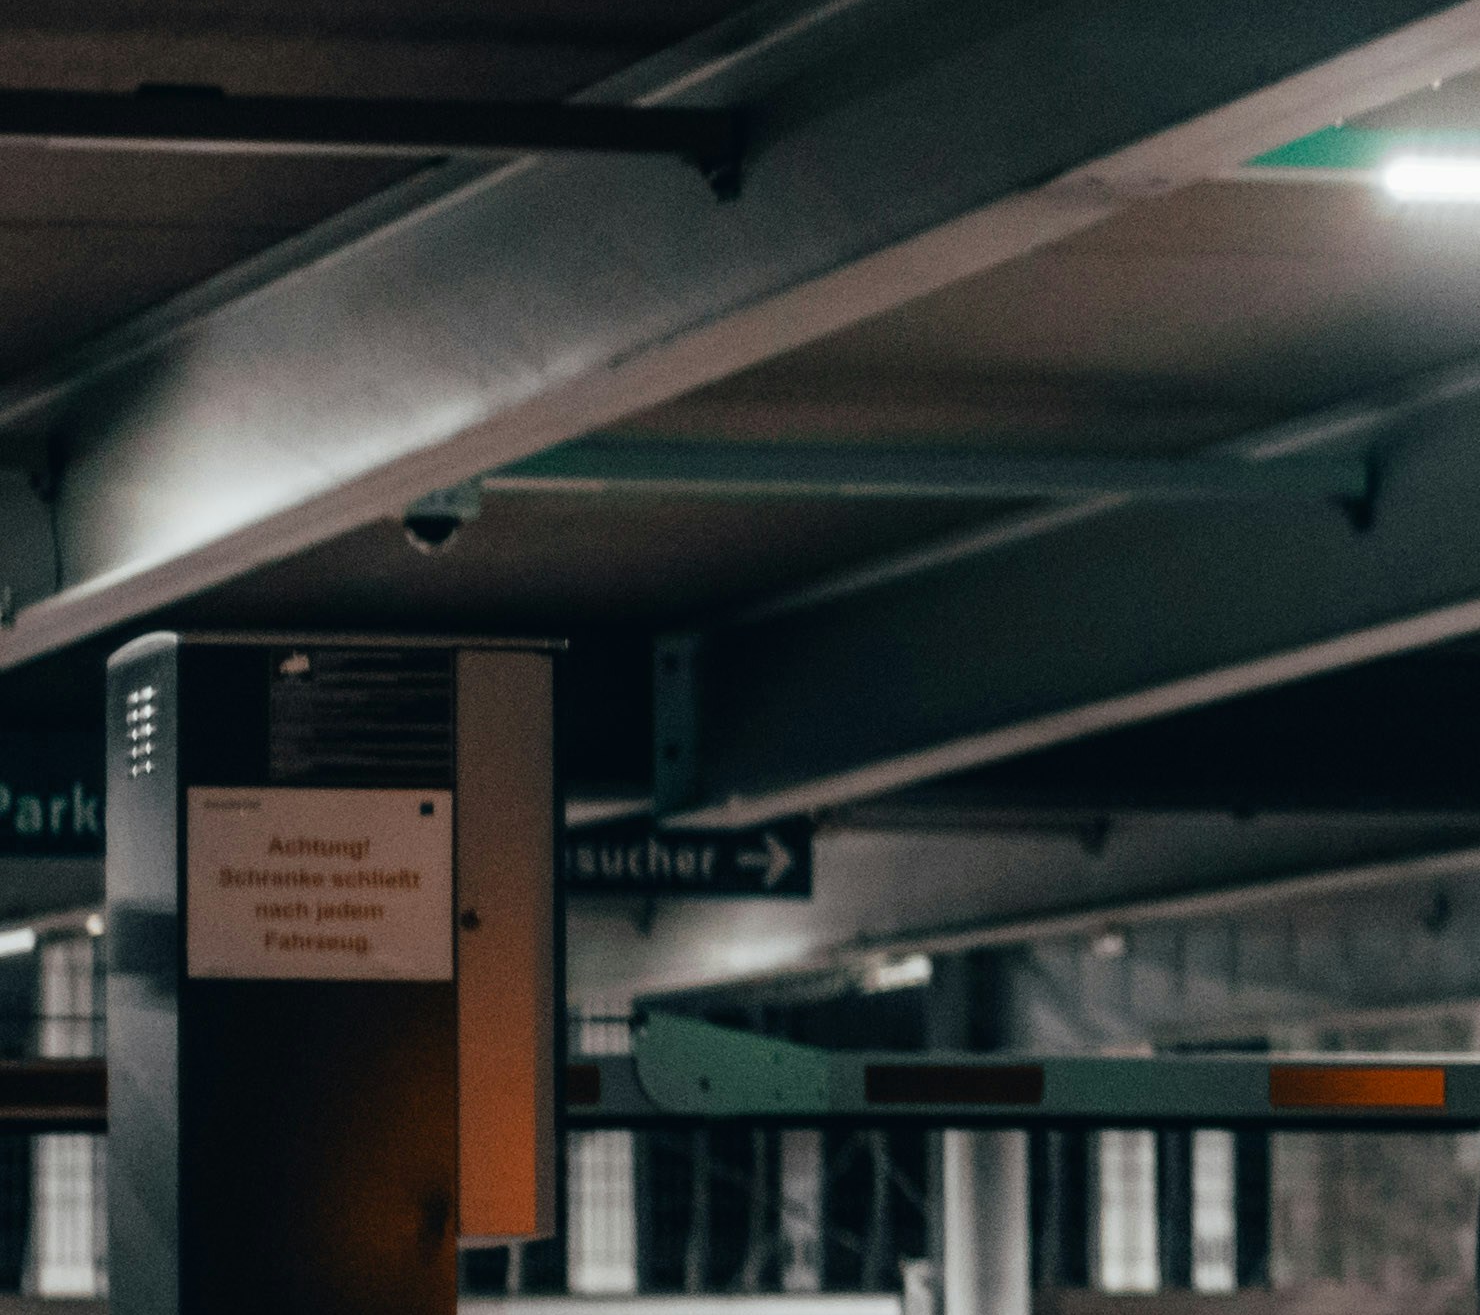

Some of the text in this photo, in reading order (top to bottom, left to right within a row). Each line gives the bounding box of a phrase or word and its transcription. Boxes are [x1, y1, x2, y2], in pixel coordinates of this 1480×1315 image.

[565, 836, 716, 878] sucher
[255, 902, 385, 925] nach jedem
